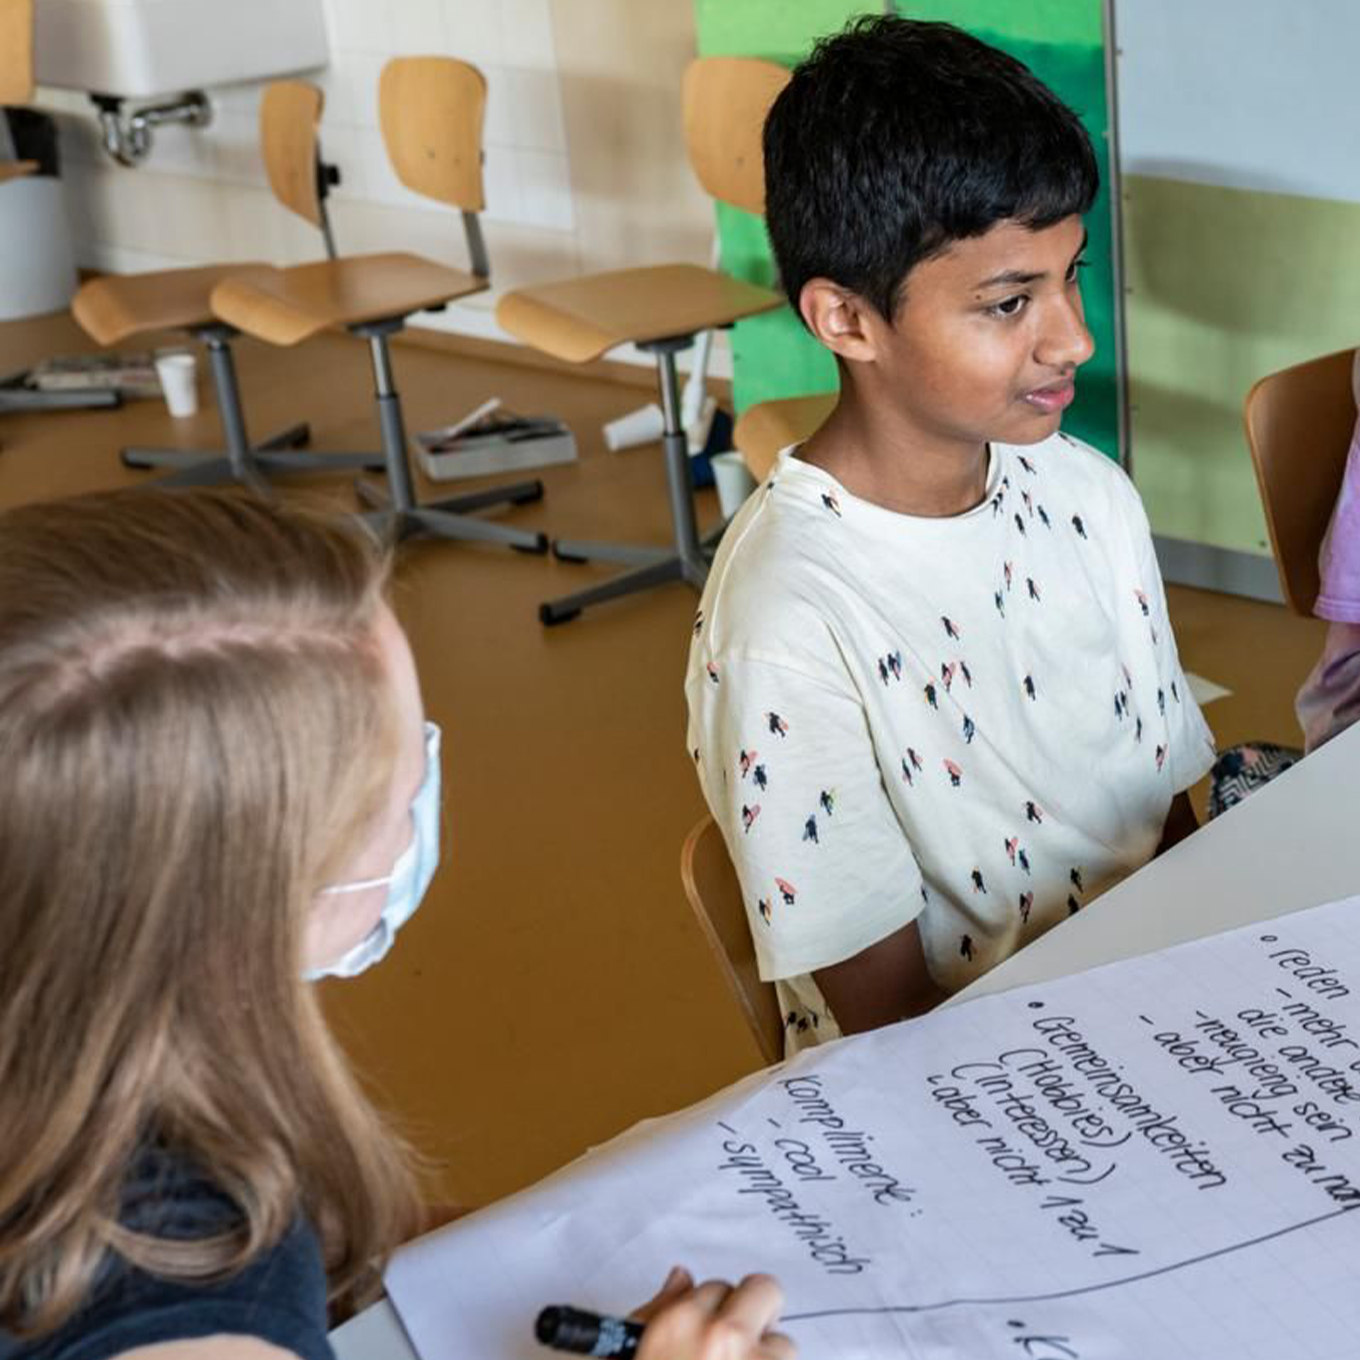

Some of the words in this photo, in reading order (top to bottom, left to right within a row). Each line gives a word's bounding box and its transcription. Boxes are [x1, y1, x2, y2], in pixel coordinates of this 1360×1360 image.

[1268, 947, 1351, 1001] reden
[1236, 1007, 1289, 1039] die
[1281, 1001, 1360, 1051] mehr
[998, 1047, 1133, 1149] (Hobbies)
[1031, 1015, 1228, 1192] Gemeinsamkeiten
[1153, 1031, 1225, 1075] aber
[1210, 1085, 1292, 1140] nicht
[1281, 1143, 1327, 1176] zu
[1292, 1100, 1353, 1143] sein
[773, 1138, 838, 1182] cool
[930, 1085, 994, 1129] aber
[976, 1136, 1053, 1188] nicht
[1057, 1208, 1100, 1243] zu
[717, 1139, 872, 1275] sympathisch
